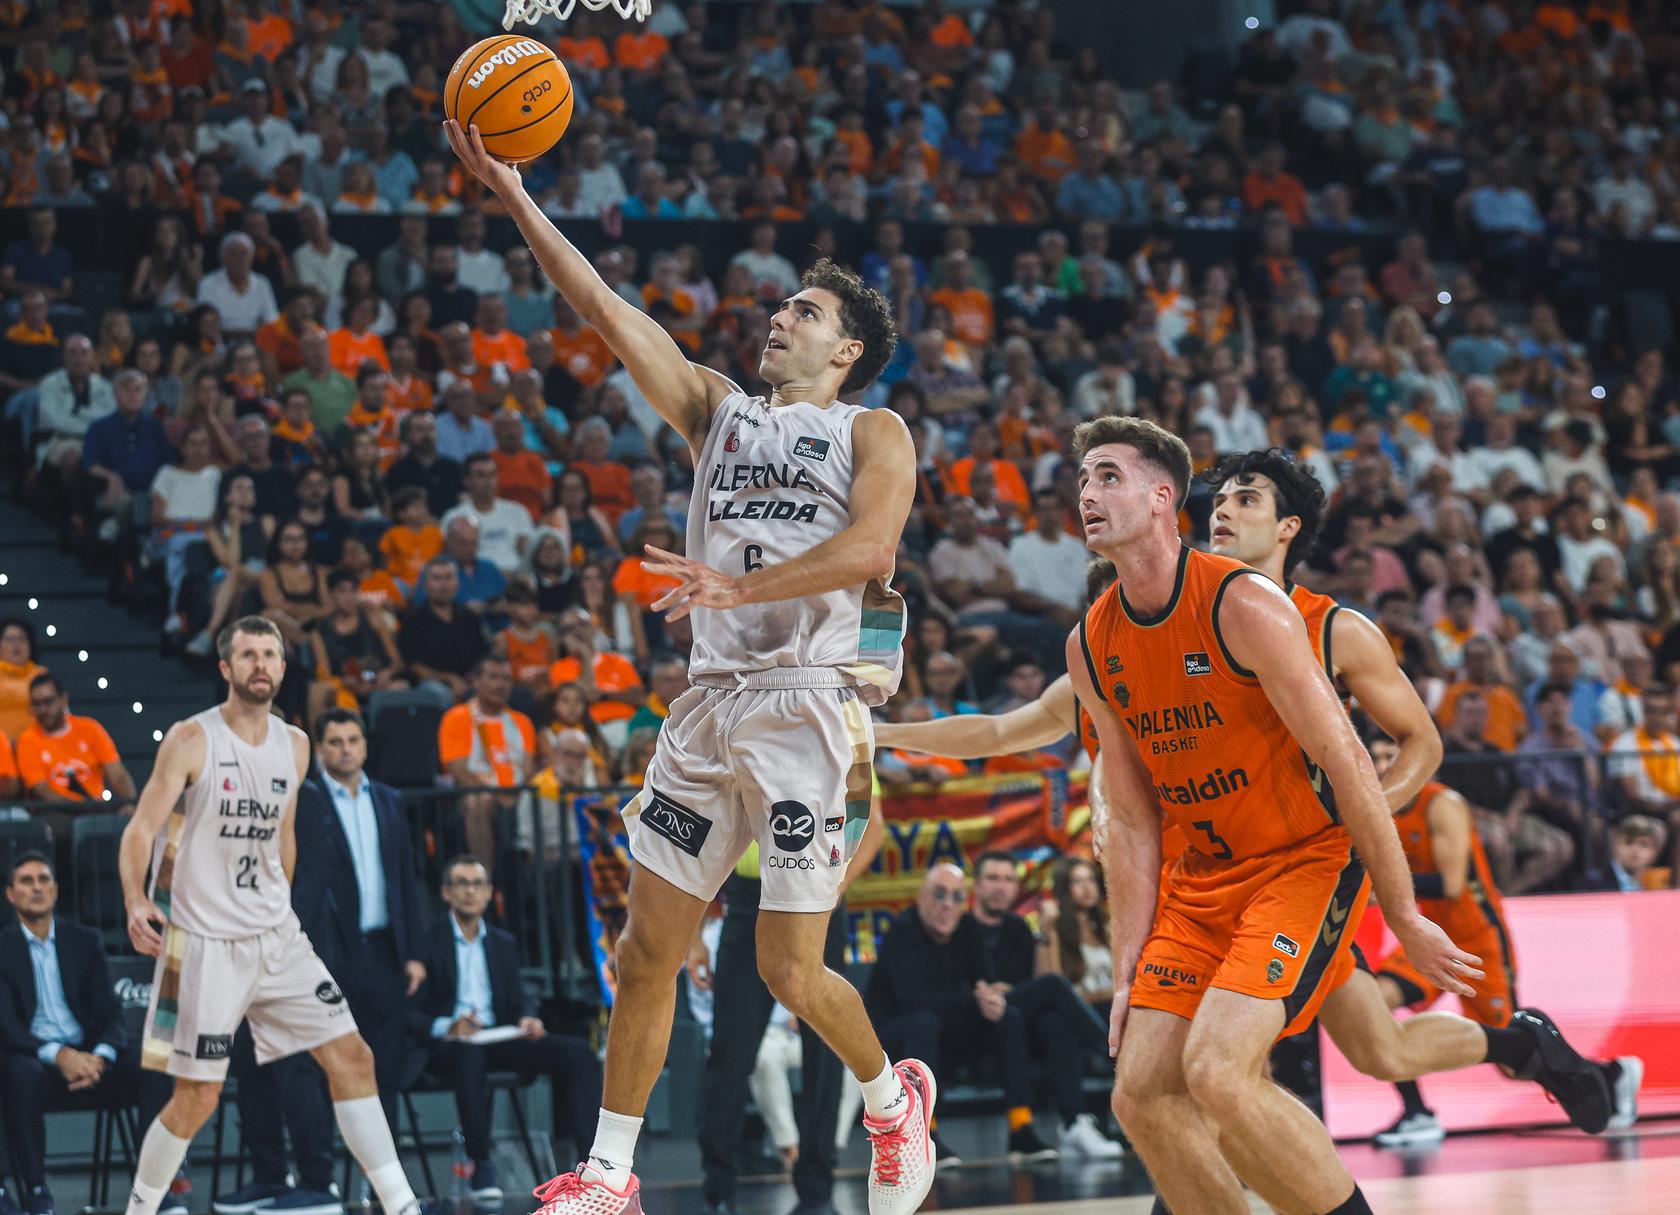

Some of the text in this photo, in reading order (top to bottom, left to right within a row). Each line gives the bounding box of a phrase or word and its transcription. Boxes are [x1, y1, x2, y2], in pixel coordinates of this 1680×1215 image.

[467, 40, 545, 89] Wilson
[523, 80, 551, 102] acb
[797, 441, 811, 450] liga
[709, 501, 819, 523] LLEIDA
[744, 544, 763, 574] 6
[1125, 701, 1225, 739] VALENCIA
[1152, 736, 1199, 755] BASKET
[771, 814, 813, 837] Q2
[826, 823, 839, 831] acb
[1192, 820, 1233, 859] 3
[769, 856, 815, 870] CUDÓS
[1276, 940, 1292, 953] acb
[1143, 963, 1197, 985] PULEVA
